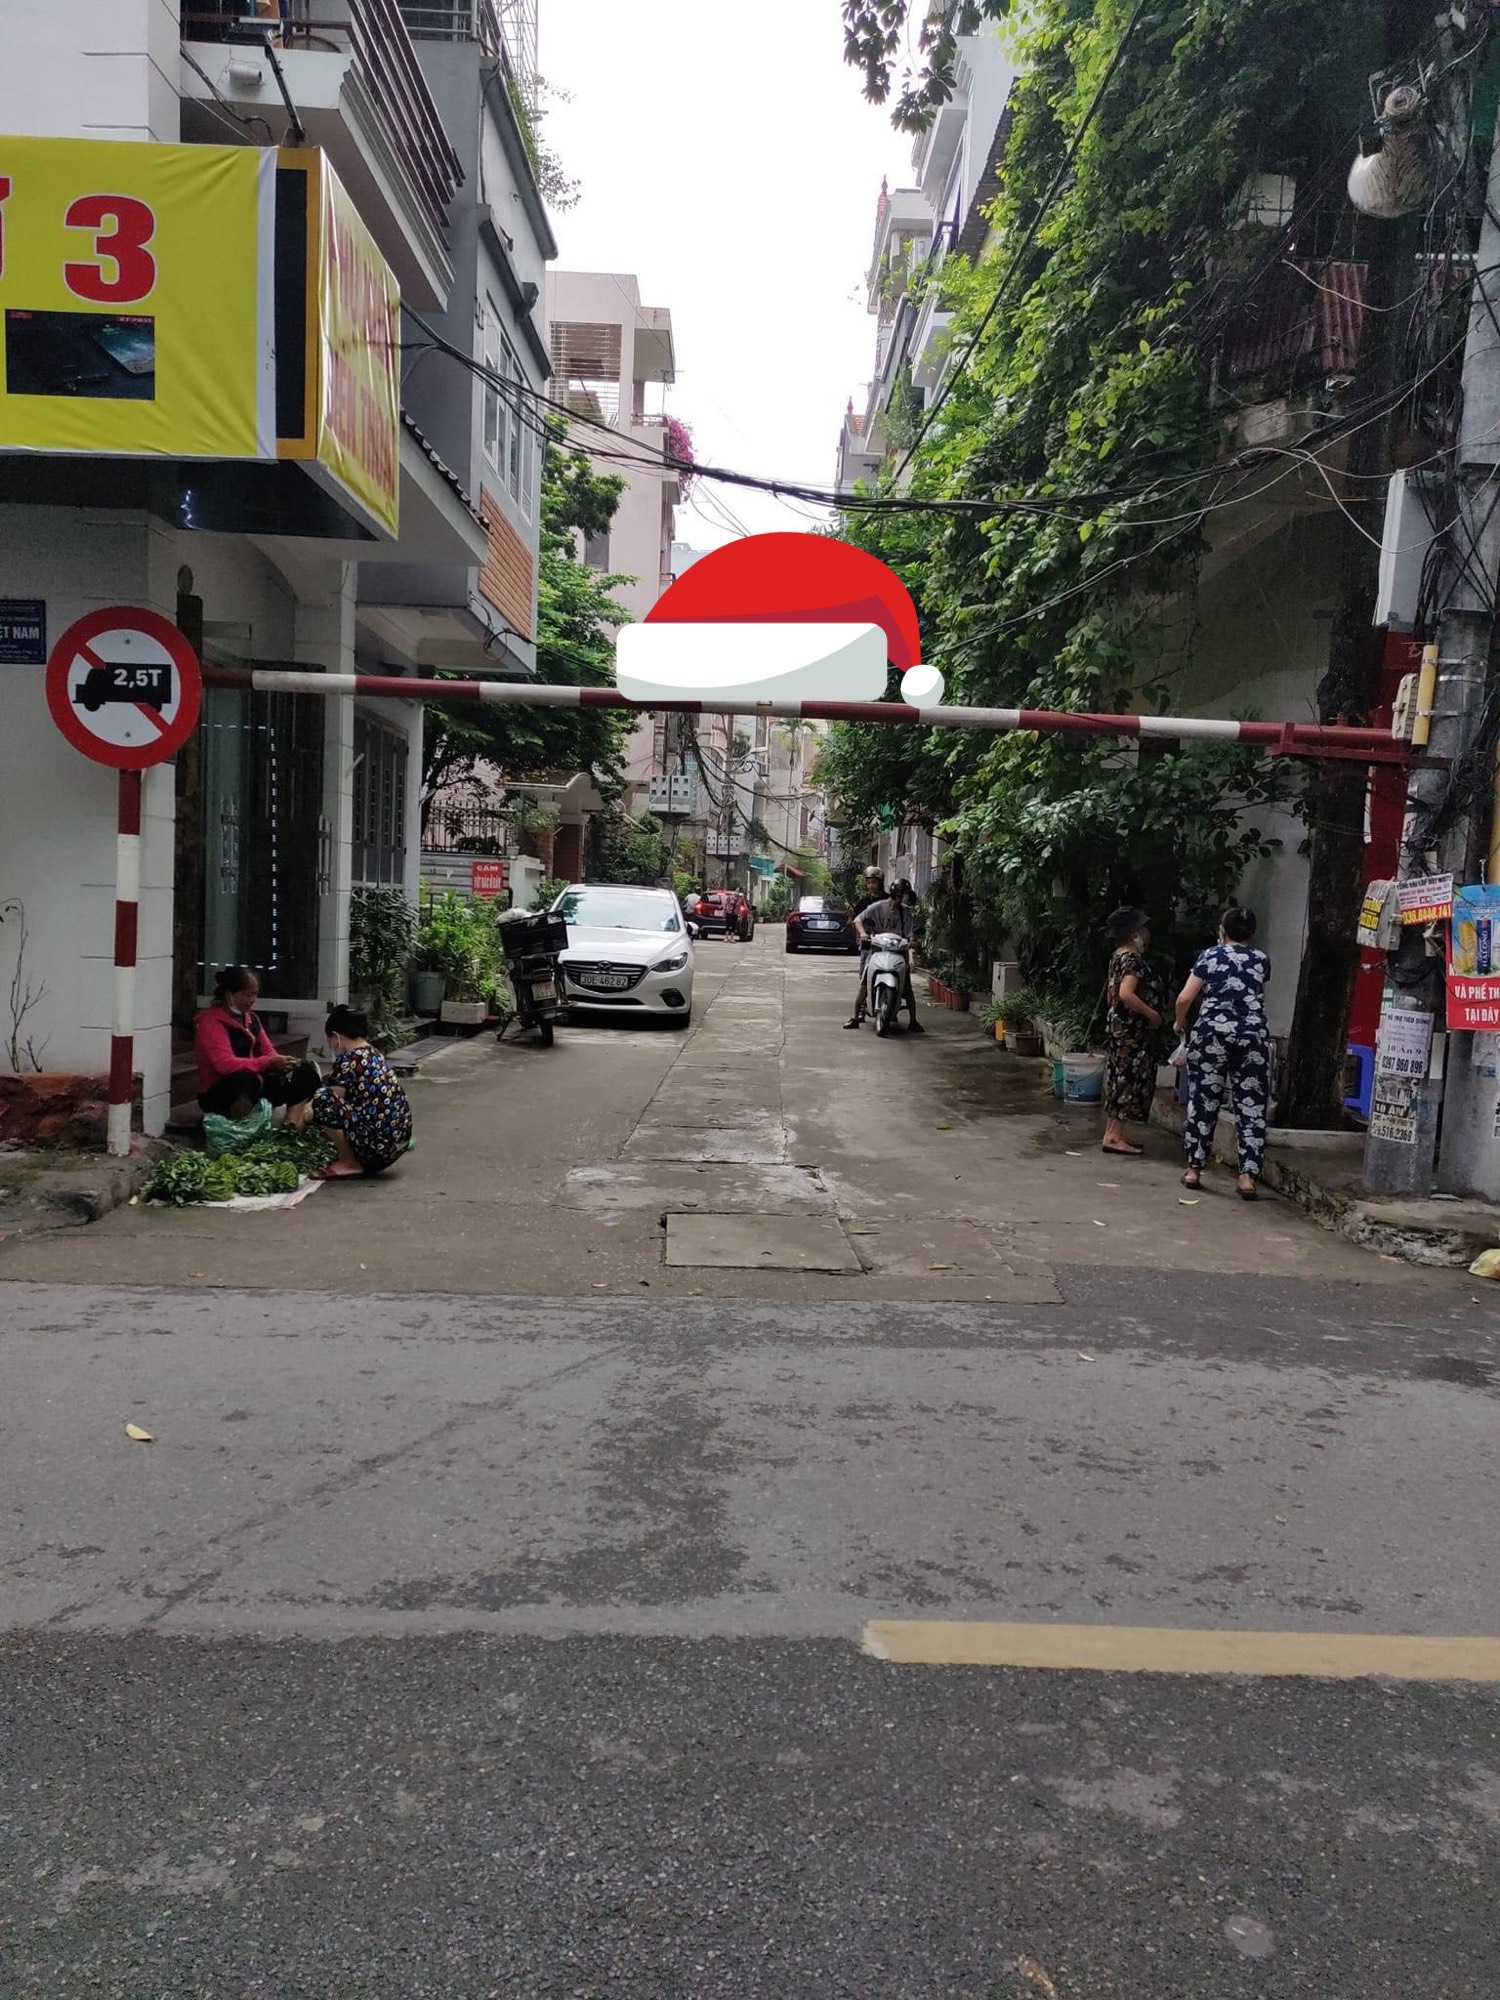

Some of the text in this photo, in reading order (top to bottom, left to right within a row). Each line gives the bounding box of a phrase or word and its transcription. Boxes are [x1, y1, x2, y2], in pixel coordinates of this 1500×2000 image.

[12, 626, 39, 640] NAM
[113, 668, 162, 688] 2,5T
[1454, 983, 1467, 999] VÀ
[1468, 982, 1487, 1000] PHẾ
[1464, 1007, 1480, 1024] TẠI
